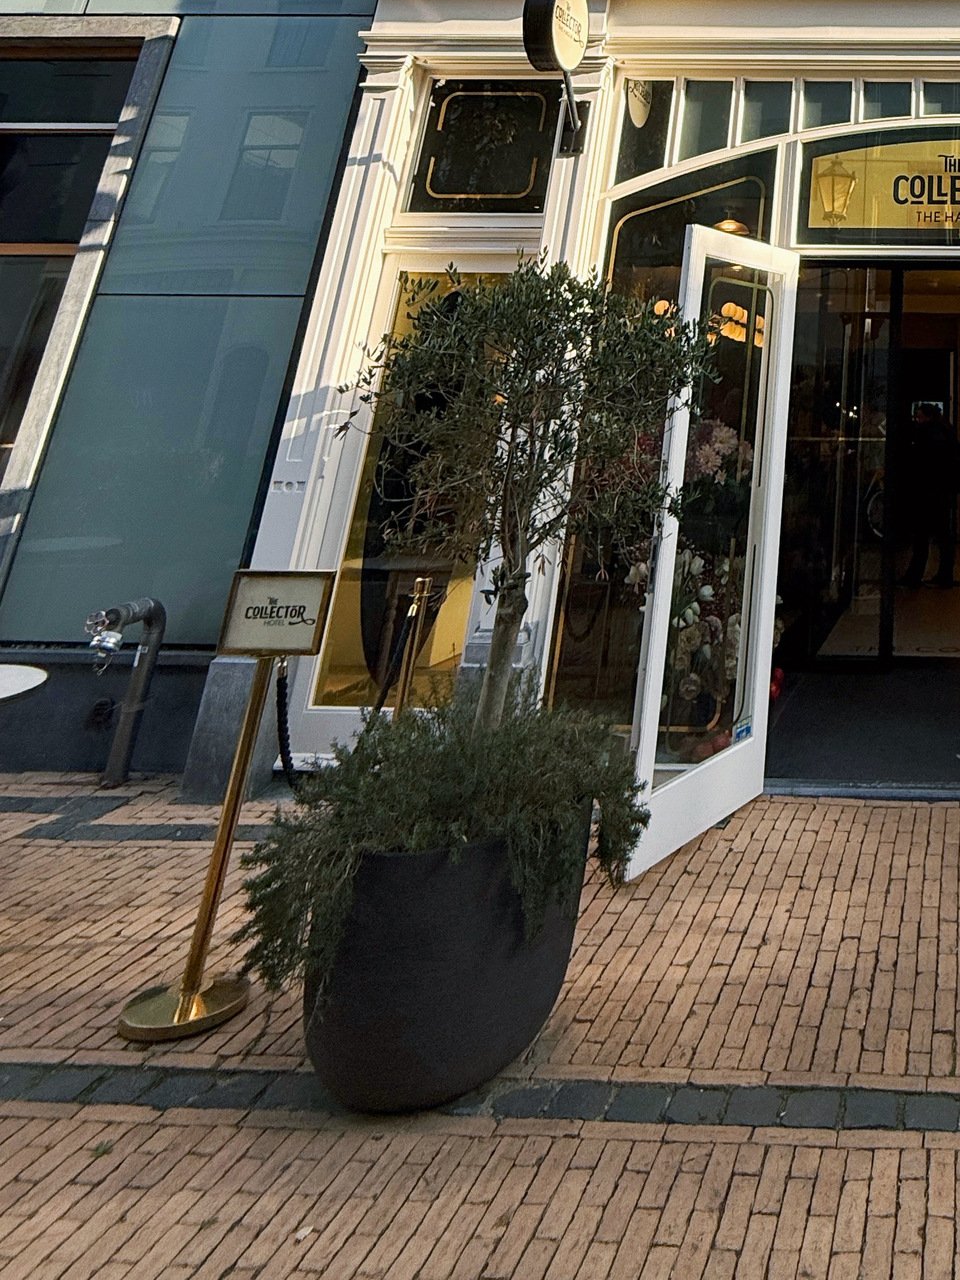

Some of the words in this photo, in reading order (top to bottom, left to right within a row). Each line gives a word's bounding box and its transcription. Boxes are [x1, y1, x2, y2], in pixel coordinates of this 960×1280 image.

[916, 211, 941, 223] THE
[245, 605, 316, 626] COLLECTOR
[263, 619, 286, 627] HOTEL
